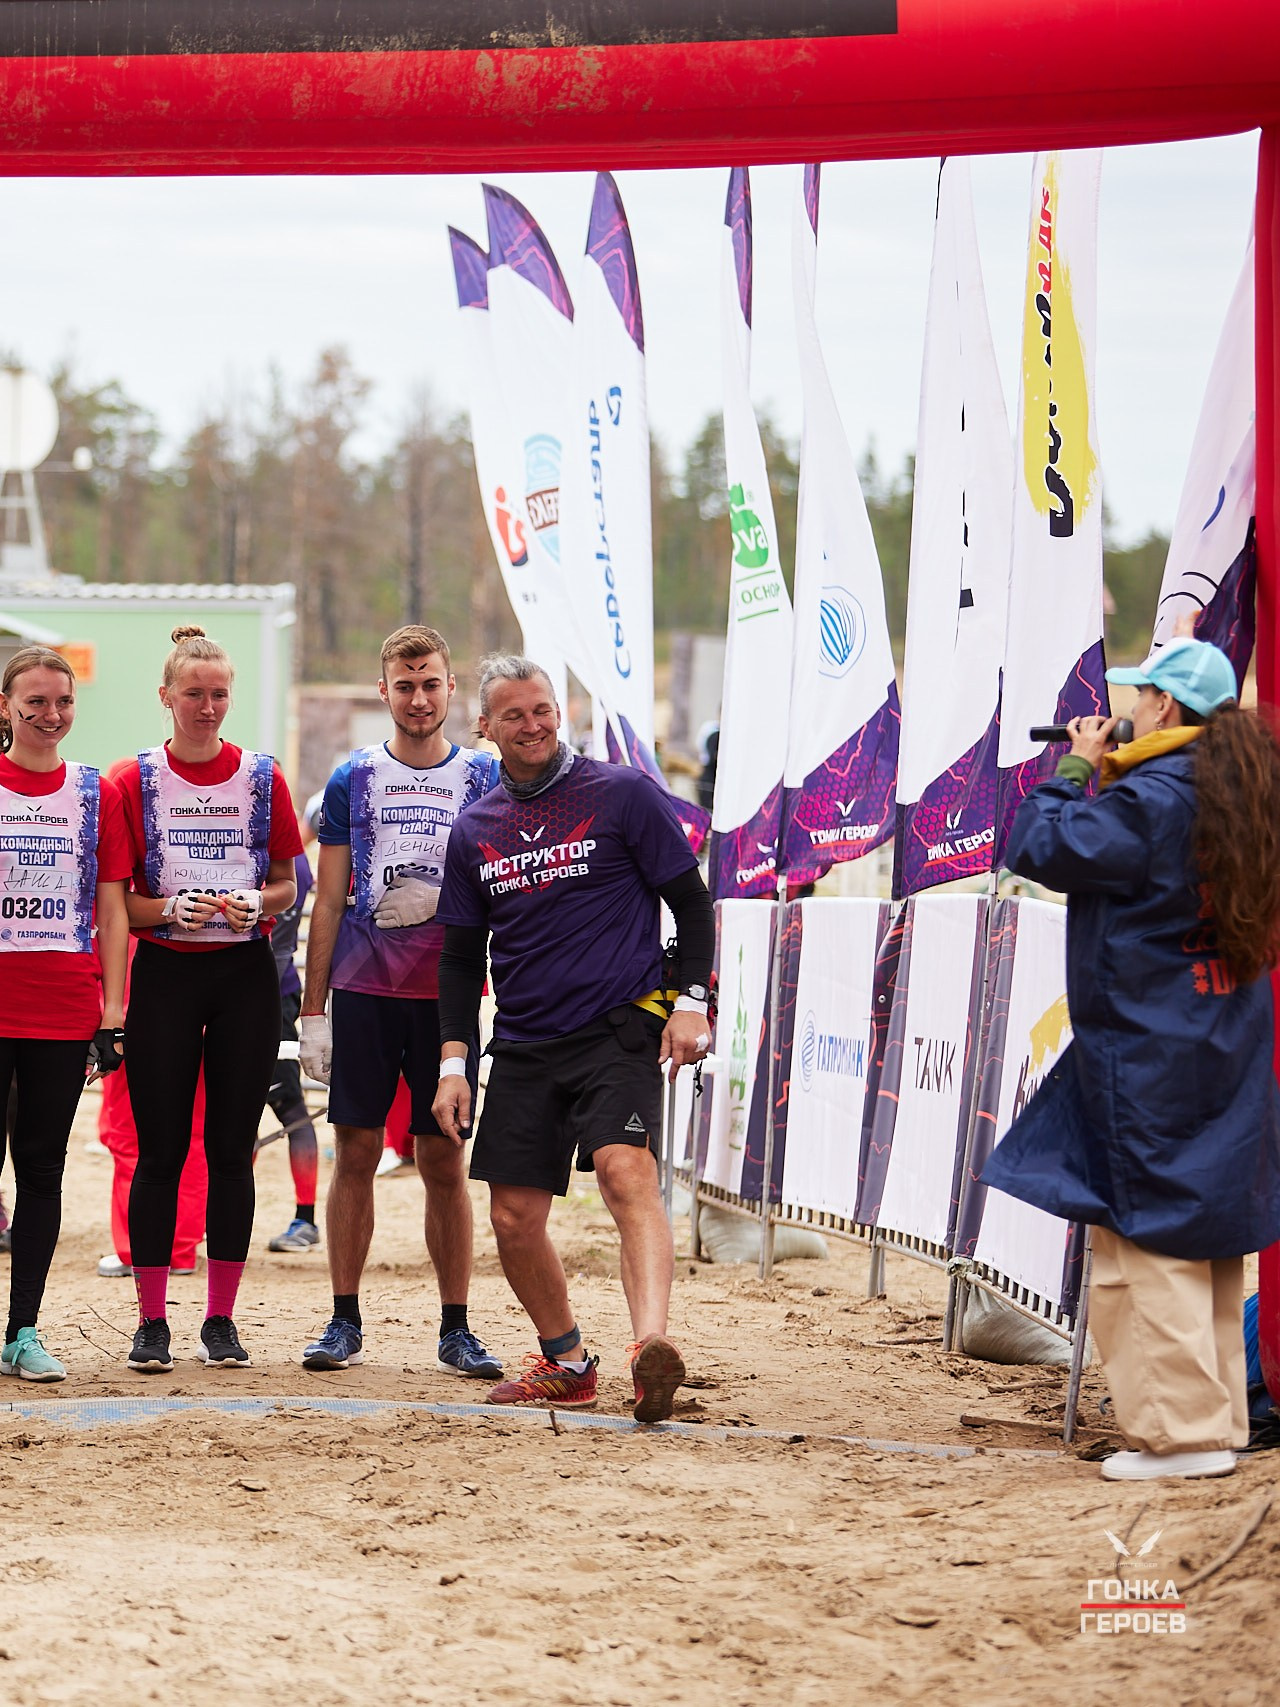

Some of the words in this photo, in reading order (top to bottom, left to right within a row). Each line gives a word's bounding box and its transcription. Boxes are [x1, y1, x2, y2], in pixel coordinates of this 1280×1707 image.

[385, 785, 416, 793] ГОНКА
[420, 785, 453, 797] ГЕРОЕВ
[170, 807, 200, 815] ГОНКА
[204, 806, 239, 814] ГЕРОЕВ
[383, 807, 453, 825] КОМАНДНЫЙ
[34, 815, 69, 824] ГЕРОЕВ
[401, 823, 435, 834] СТАРТ
[0, 837, 72, 852] КОМАНДНЫЙ
[170, 830, 242, 846] КОМАНДНЫЙ
[21, 852, 53, 865] СТАРТ
[190, 846, 223, 858] СТАРТ
[480, 840, 597, 882] ИНСТРУКТОР
[490, 875, 531, 896] ГОНКА
[533, 863, 589, 884] ГЕРОЕВ
[2, 897, 66, 920] 03209
[17, 931, 66, 940] ГАЗПРОМБАНК
[914, 1036, 957, 1095] TANK
